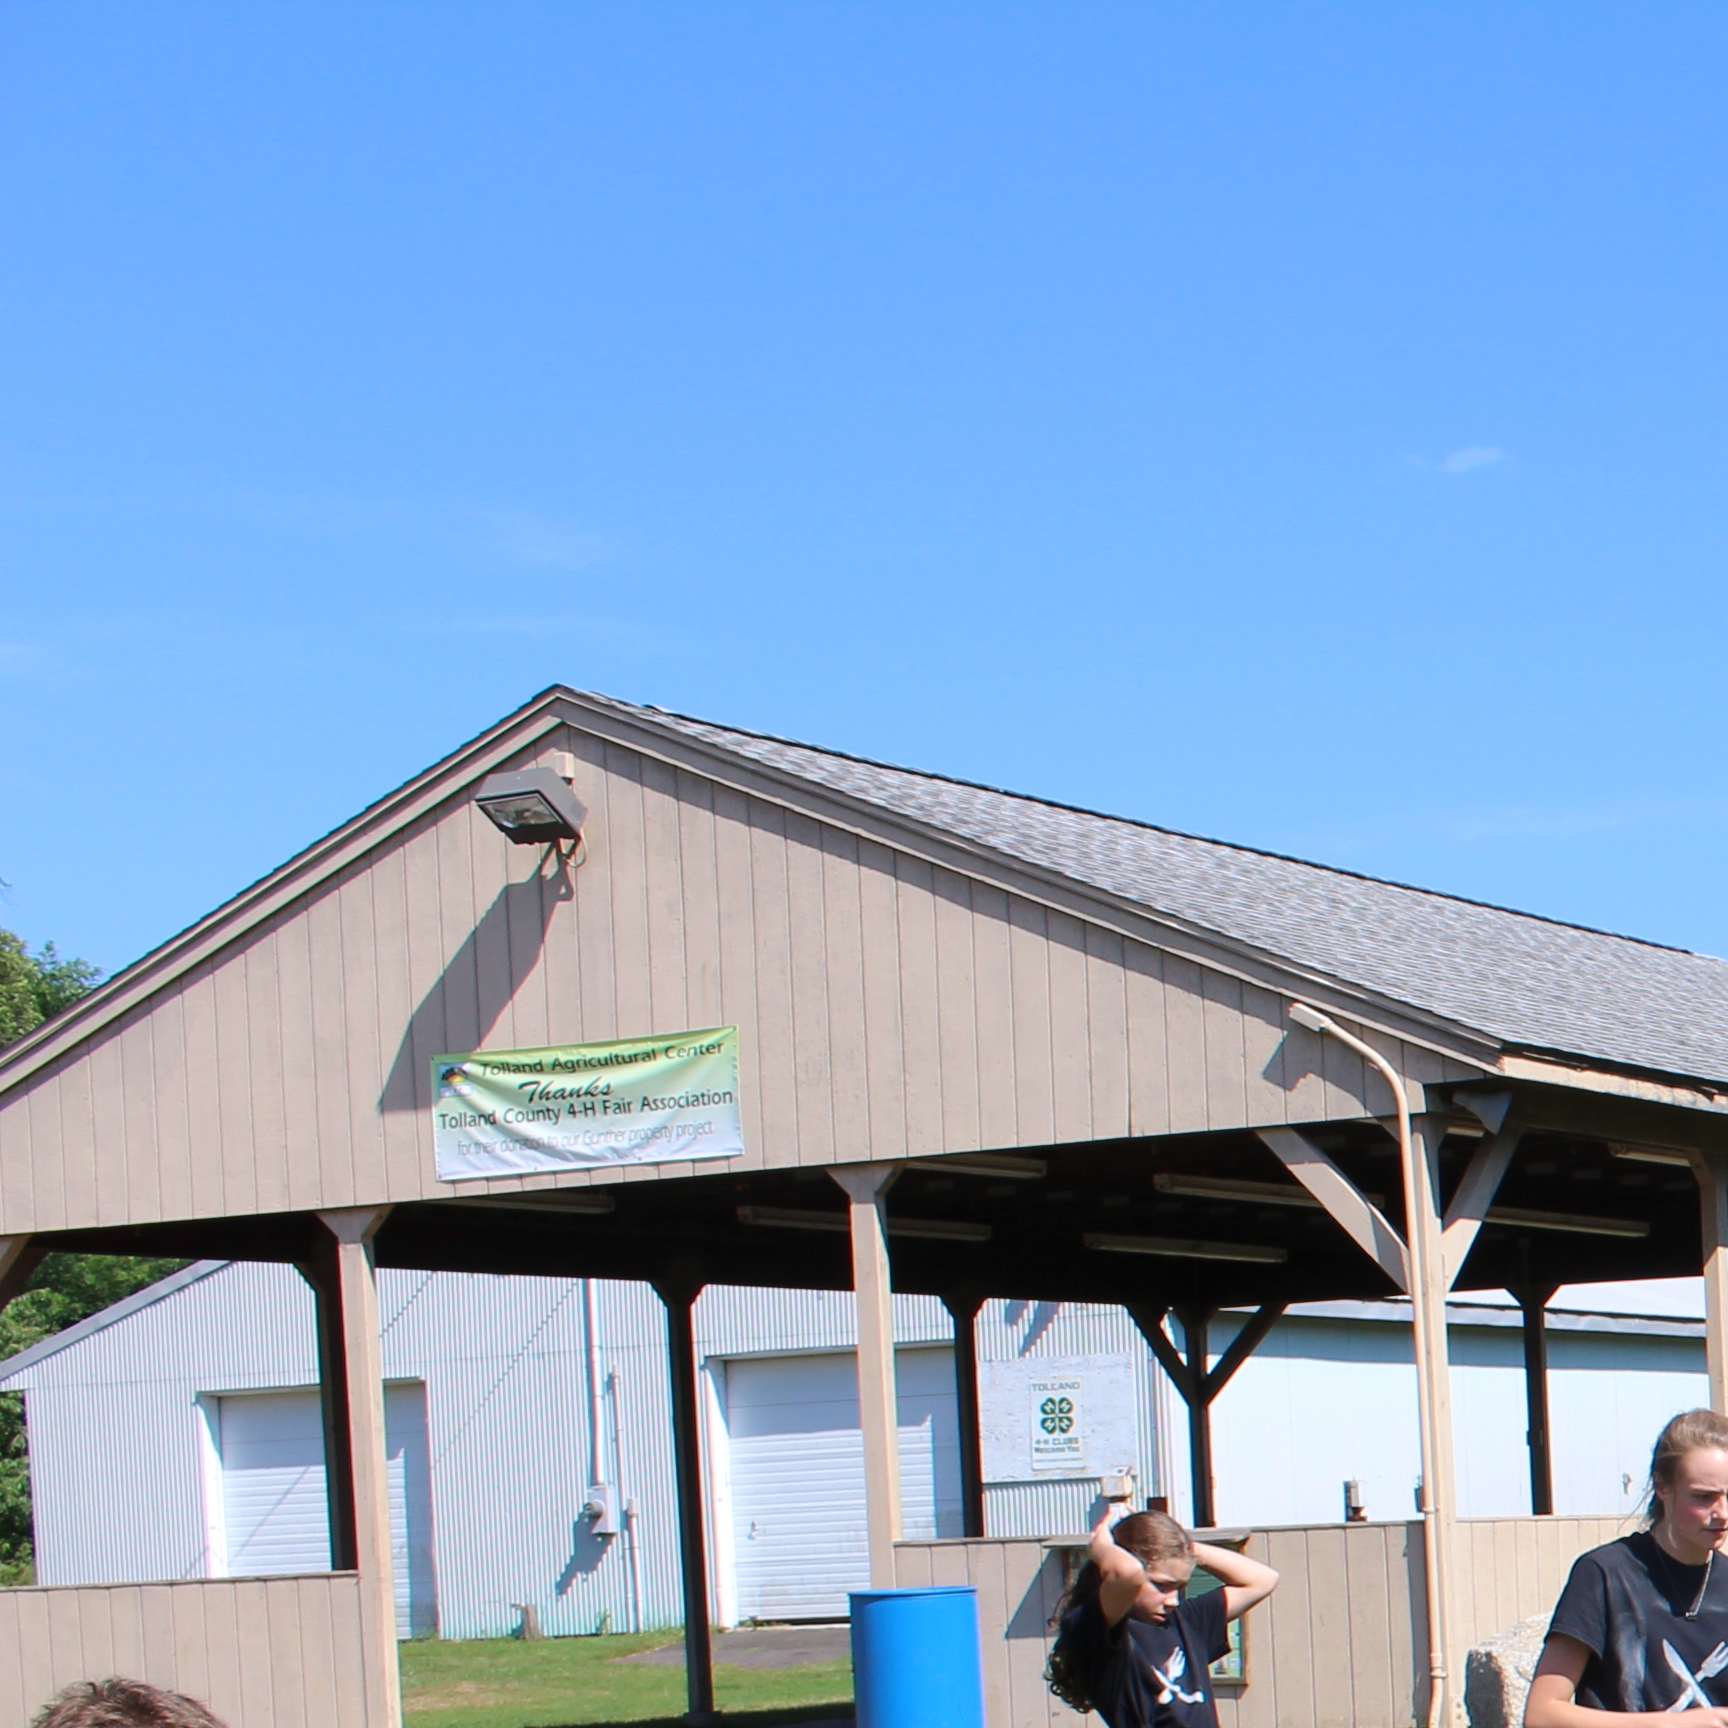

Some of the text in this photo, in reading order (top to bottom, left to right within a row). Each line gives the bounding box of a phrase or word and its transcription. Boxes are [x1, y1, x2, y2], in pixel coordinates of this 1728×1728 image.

[481, 1042, 724, 1077] Tolland Agricultural Center
[518, 1076, 613, 1103] Thanks
[439, 1088, 733, 1129] Tolland County 4-H Fair Association
[458, 1141, 472, 1156] for
[475, 1139, 498, 1154] their
[547, 1135, 558, 1148] to
[561, 1135, 581, 1147] our
[629, 1125, 674, 1144] property
[677, 1120, 713, 1140] project
[1032, 1381, 1080, 1392] TOLLAND
